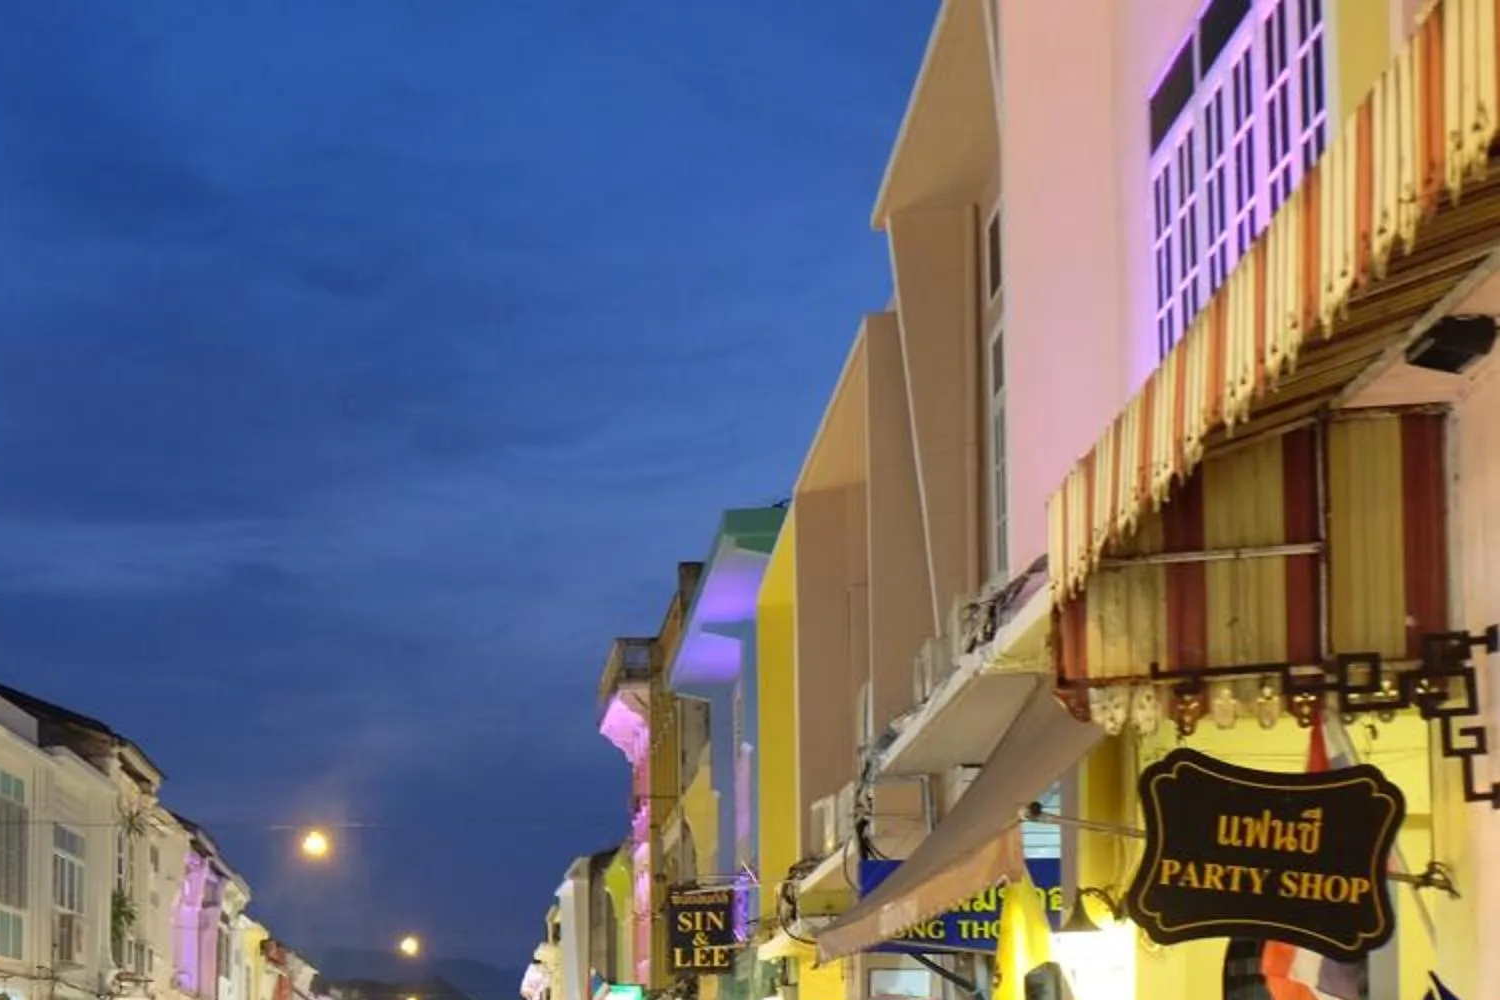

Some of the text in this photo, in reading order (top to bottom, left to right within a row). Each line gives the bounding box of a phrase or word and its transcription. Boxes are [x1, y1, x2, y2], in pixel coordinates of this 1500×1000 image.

[1216, 807, 1323, 854] แฟนซี
[1159, 859, 1371, 904] PARTY SHOP
[677, 911, 725, 933] SIN
[692, 931, 710, 947] &
[674, 947, 729, 968] LEE
